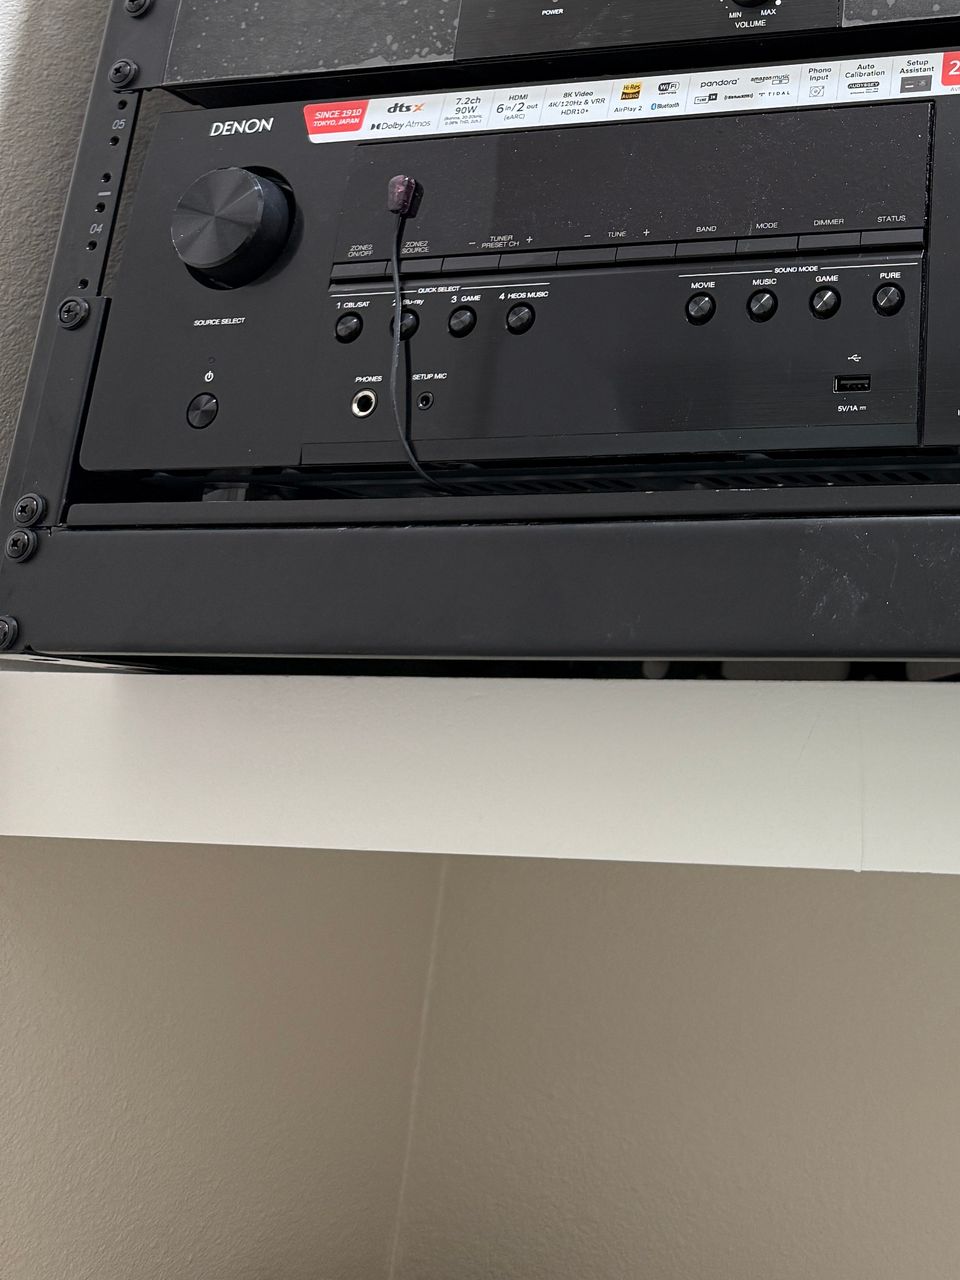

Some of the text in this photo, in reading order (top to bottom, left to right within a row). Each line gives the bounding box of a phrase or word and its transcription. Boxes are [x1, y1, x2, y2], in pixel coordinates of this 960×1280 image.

[729, 11, 742, 19] MIN
[761, 8, 776, 16] MAX
[735, 19, 766, 28] VOLUME
[907, 59, 928, 68] Setup
[948, 60, 960, 75] 2
[845, 70, 885, 78] Calibration
[900, 66, 934, 74] Assistant
[700, 80, 738, 88] pandora
[456, 97, 481, 105] 7.2ch
[315, 109, 361, 119] SINCE 1910
[455, 106, 477, 114] 90W
[111, 119, 126, 130] 05
[209, 118, 274, 137] DENON
[382, 120, 430, 131] Dolby Atmos
[813, 218, 844, 226] DIMMER
[877, 215, 906, 223] STATUS
[89, 223, 103, 233] 04
[756, 222, 778, 230] MODE
[348, 250, 374, 258] ON/OFF
[815, 275, 838, 283] GAME
[879, 272, 901, 280] PURE
[691, 281, 715, 289] MOVIE
[752, 278, 777, 286] MUSIC
[194, 317, 245, 326] SOURCE SELECT
